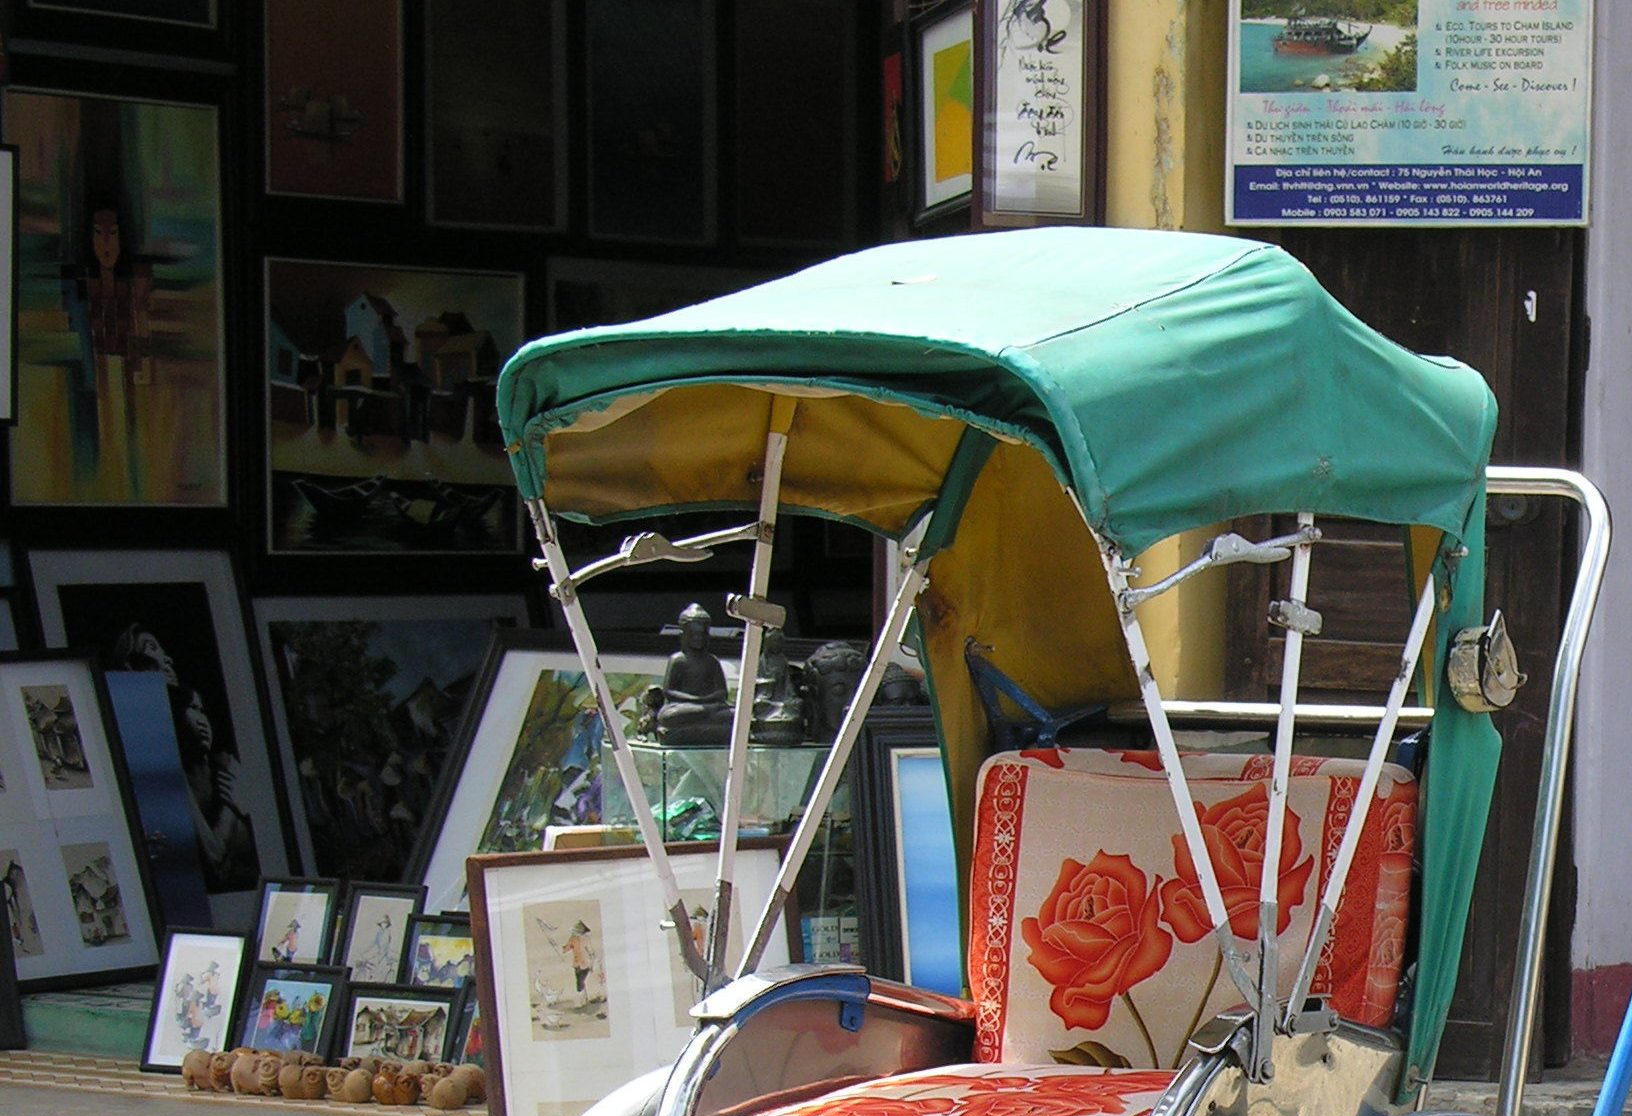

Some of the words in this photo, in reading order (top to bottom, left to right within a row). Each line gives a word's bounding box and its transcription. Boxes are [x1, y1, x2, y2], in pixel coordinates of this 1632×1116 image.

[1489, 34, 1502, 44] 30
[1450, 78, 1481, 91] Come
[1493, 78, 1509, 91] See
[1521, 78, 1568, 92] Discover
[1527, 168, 1542, 177] An
[1307, 194, 1322, 204] Tel
[1410, 195, 1428, 204] Fax
[1281, 208, 1316, 217] Mobile
[1515, 208, 1535, 217] 209
